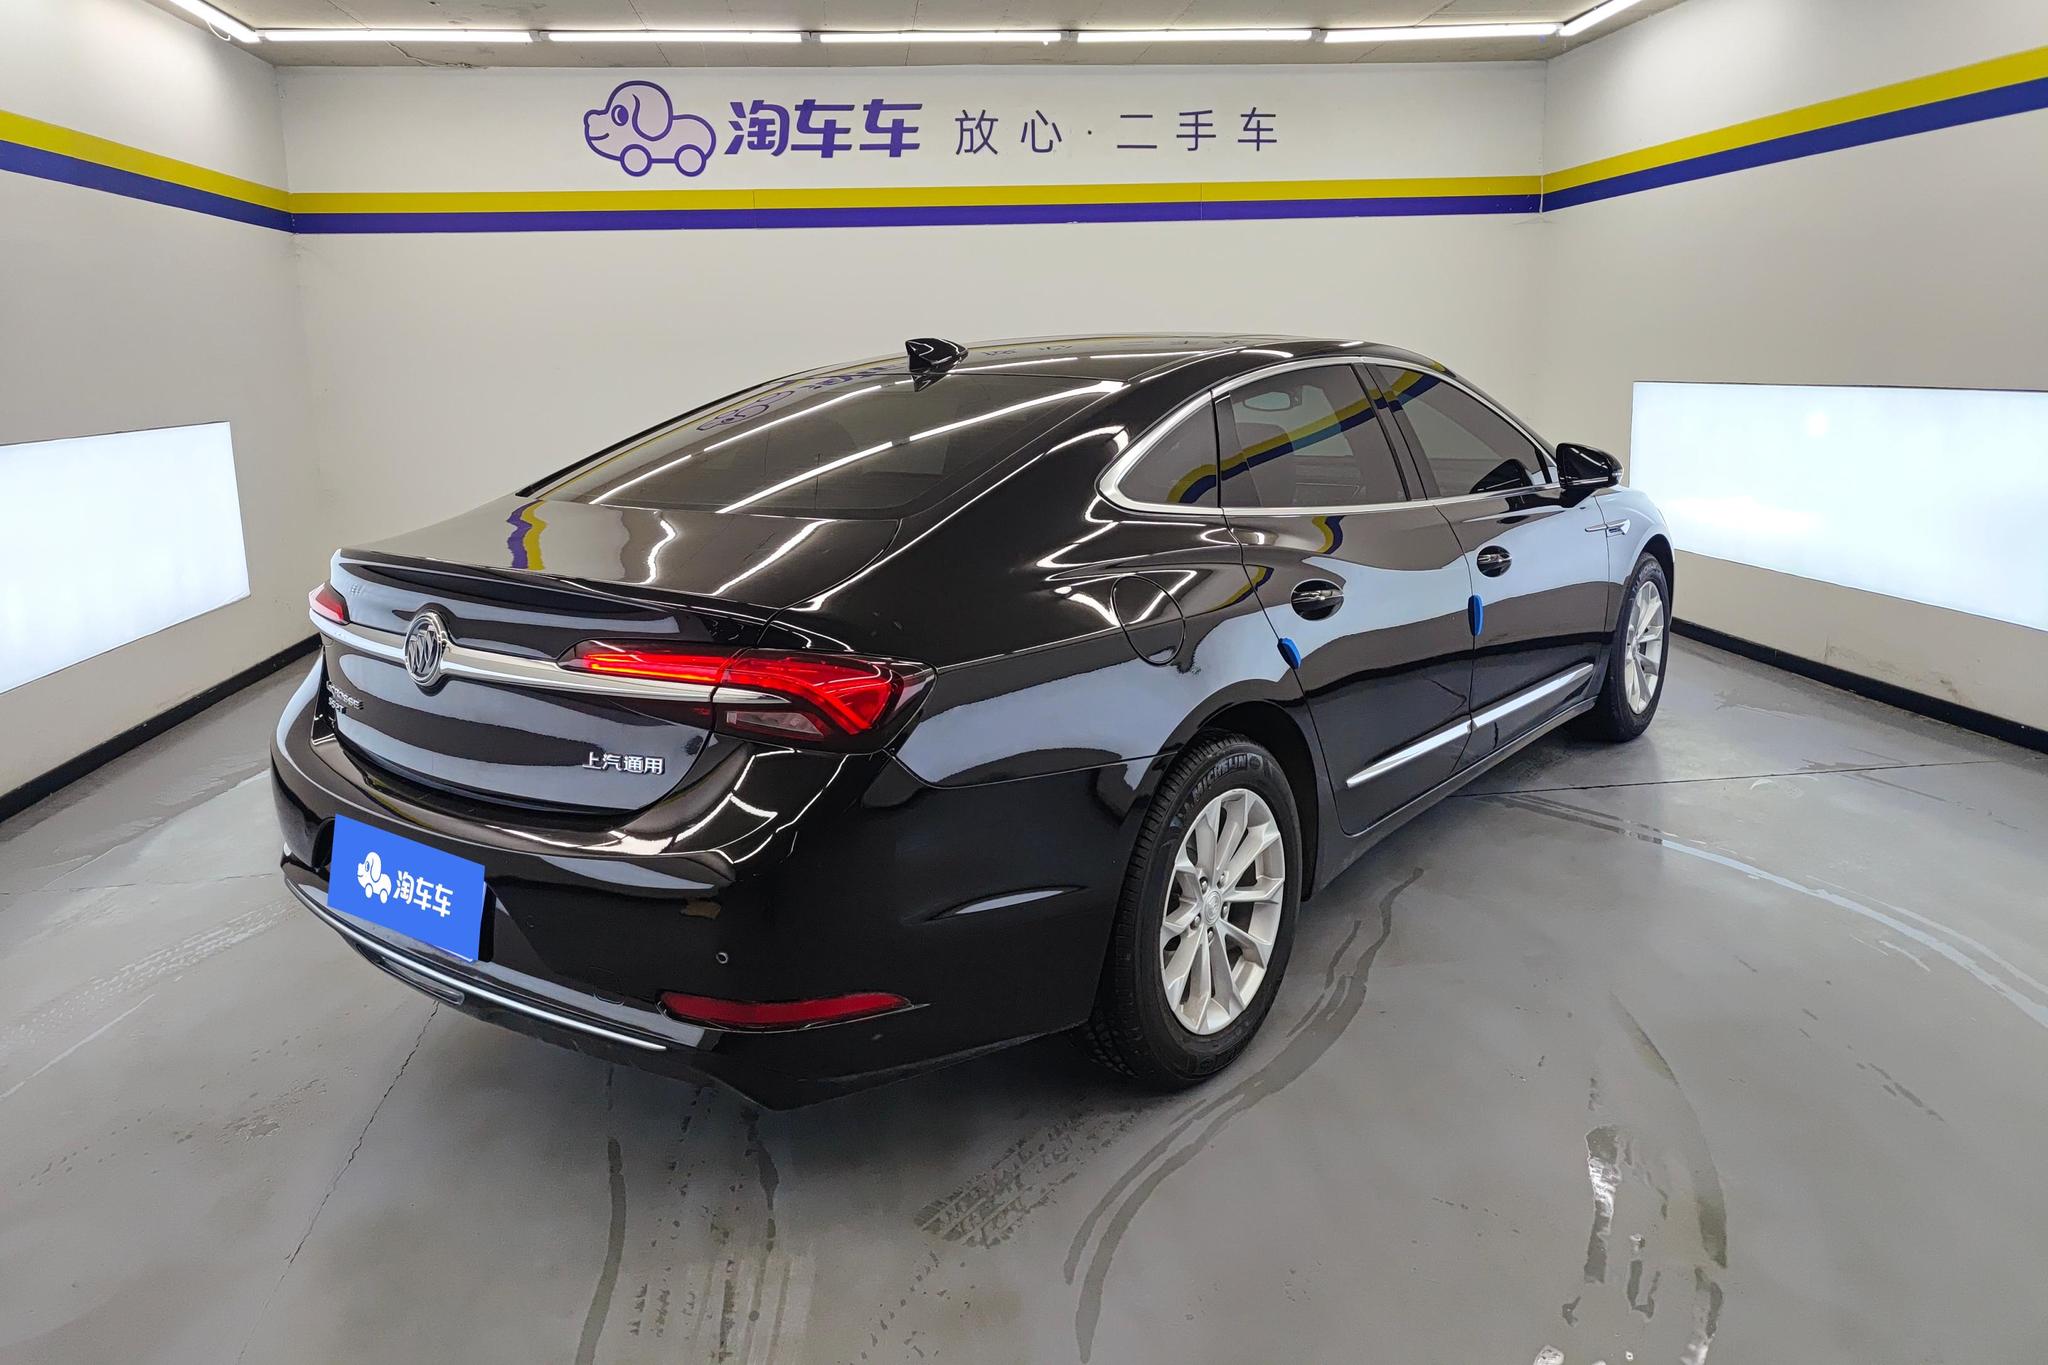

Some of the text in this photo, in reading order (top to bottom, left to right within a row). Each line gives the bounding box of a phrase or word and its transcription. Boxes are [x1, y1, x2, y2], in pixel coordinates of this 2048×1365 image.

[724, 98, 923, 159] 淘车车
[582, 751, 664, 775] 上汽通用
[1191, 754, 1248, 802] MICHELIN
